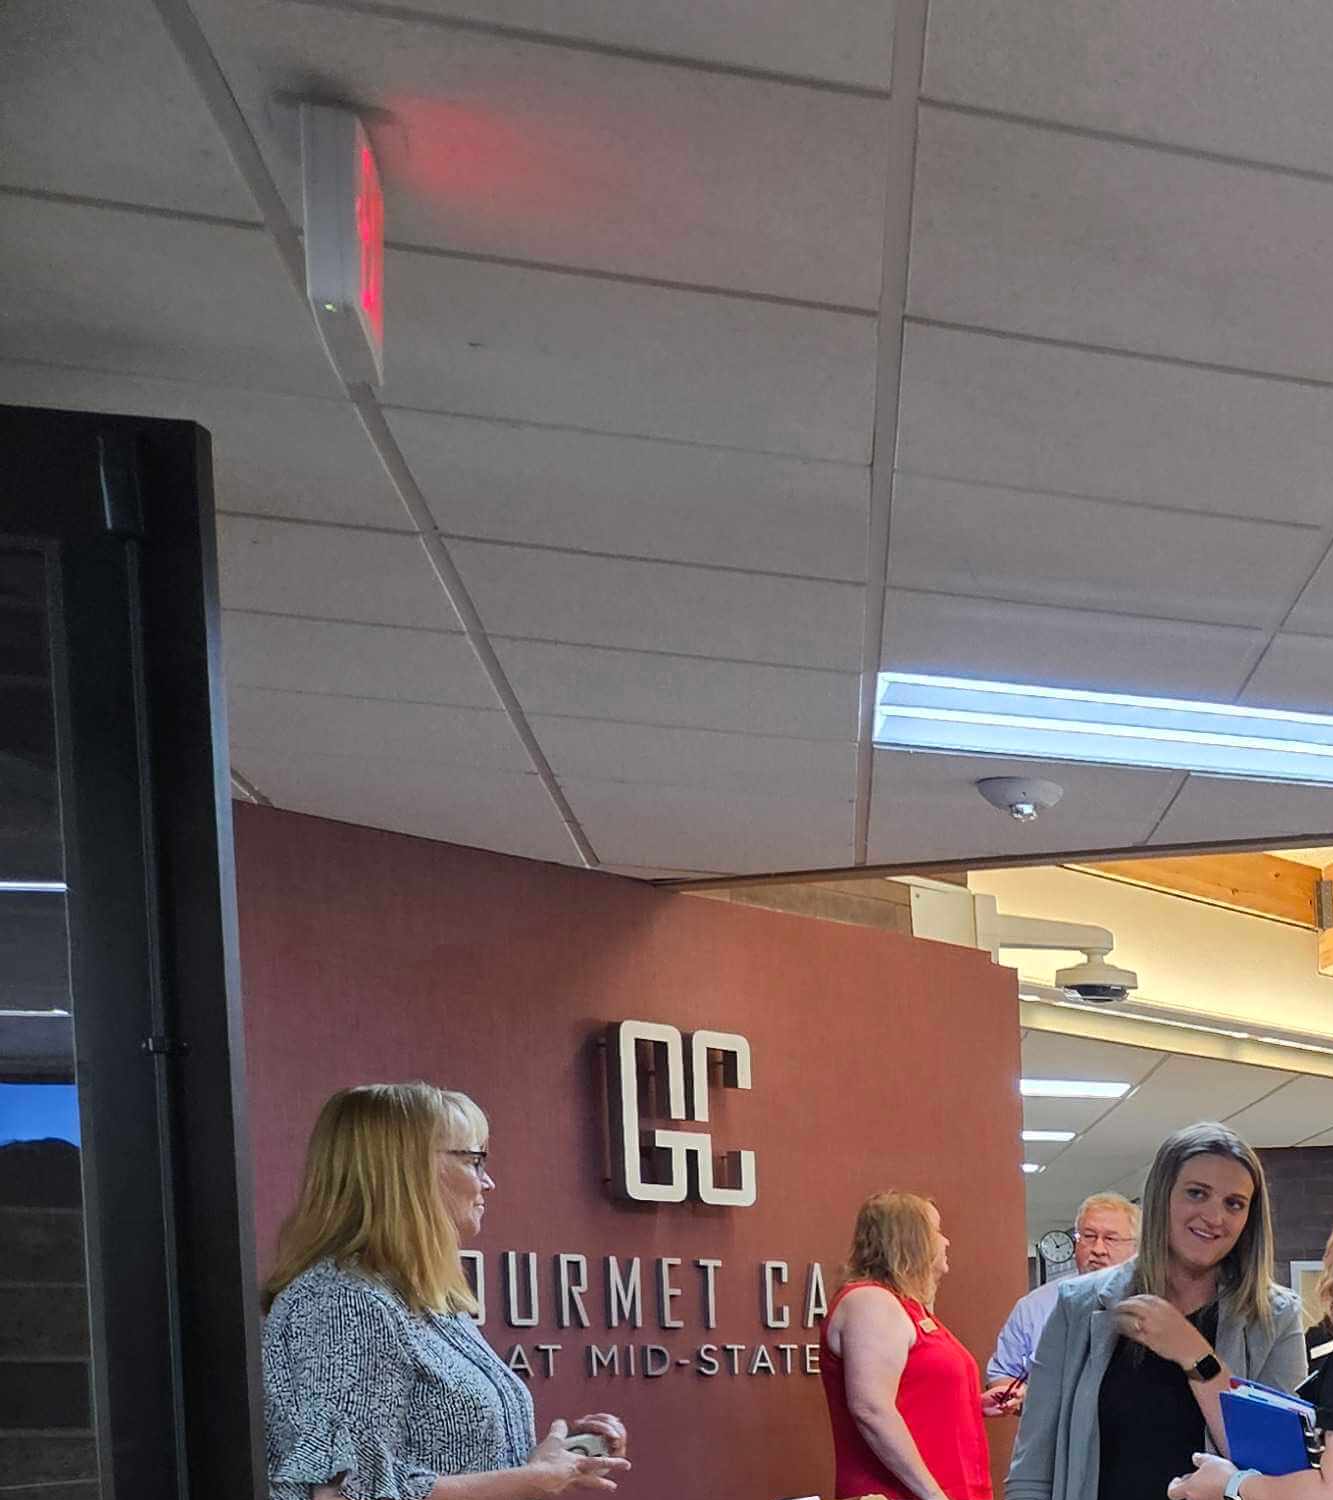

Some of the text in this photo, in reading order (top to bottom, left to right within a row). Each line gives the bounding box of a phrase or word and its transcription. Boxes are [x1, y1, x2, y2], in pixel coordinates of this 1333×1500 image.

[617, 1019, 757, 1207] GC
[458, 1250, 828, 1328] OURMET CA
[510, 1343, 821, 1377] AT MID-STATE
